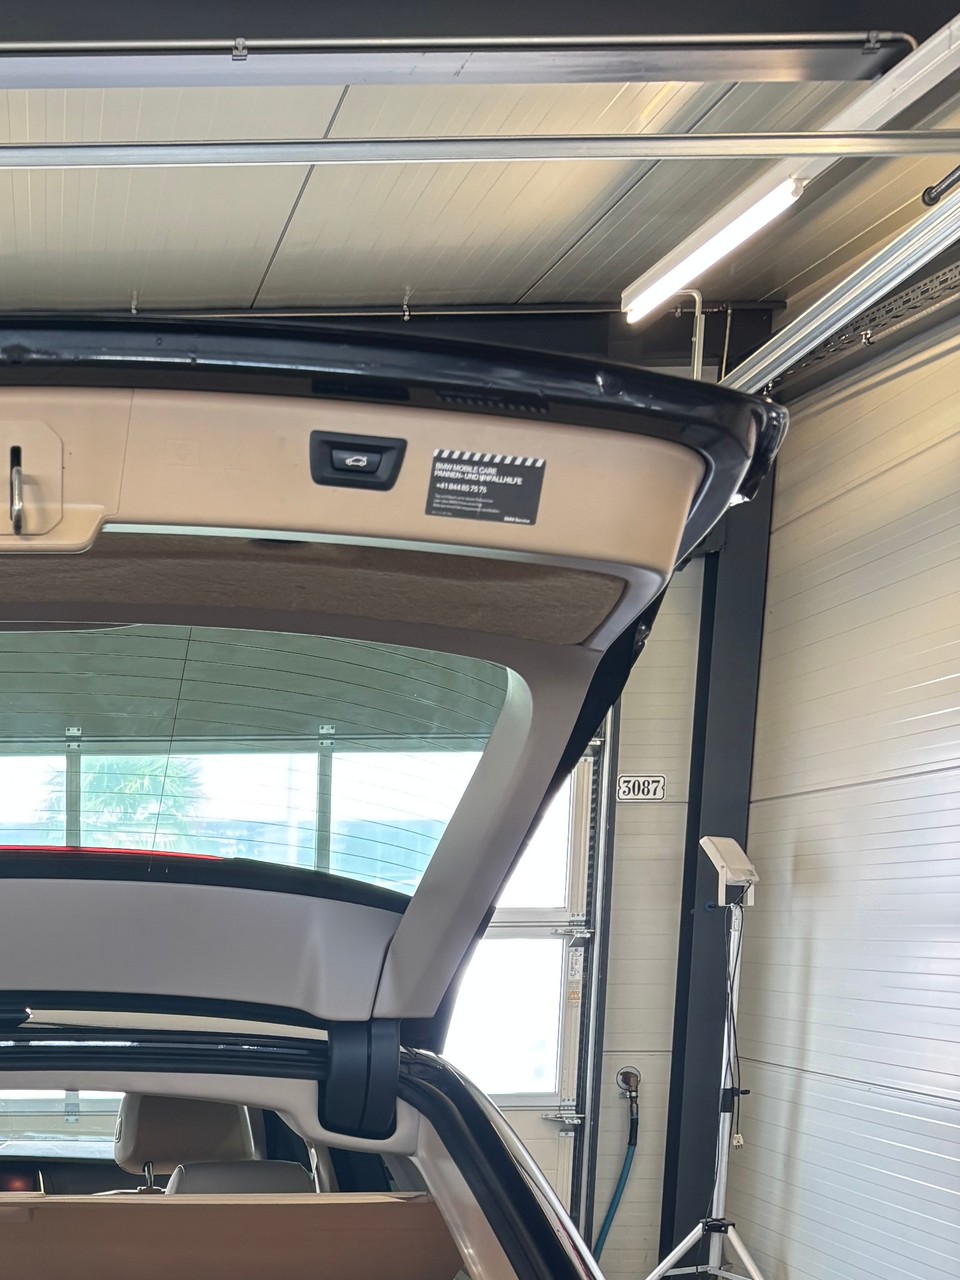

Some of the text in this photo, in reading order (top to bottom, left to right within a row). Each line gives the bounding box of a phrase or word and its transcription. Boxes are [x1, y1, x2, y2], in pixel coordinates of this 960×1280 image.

[453, 464, 478, 474] MOBILE
[479, 466, 497, 475] CARE
[622, 779, 661, 796] 3087
